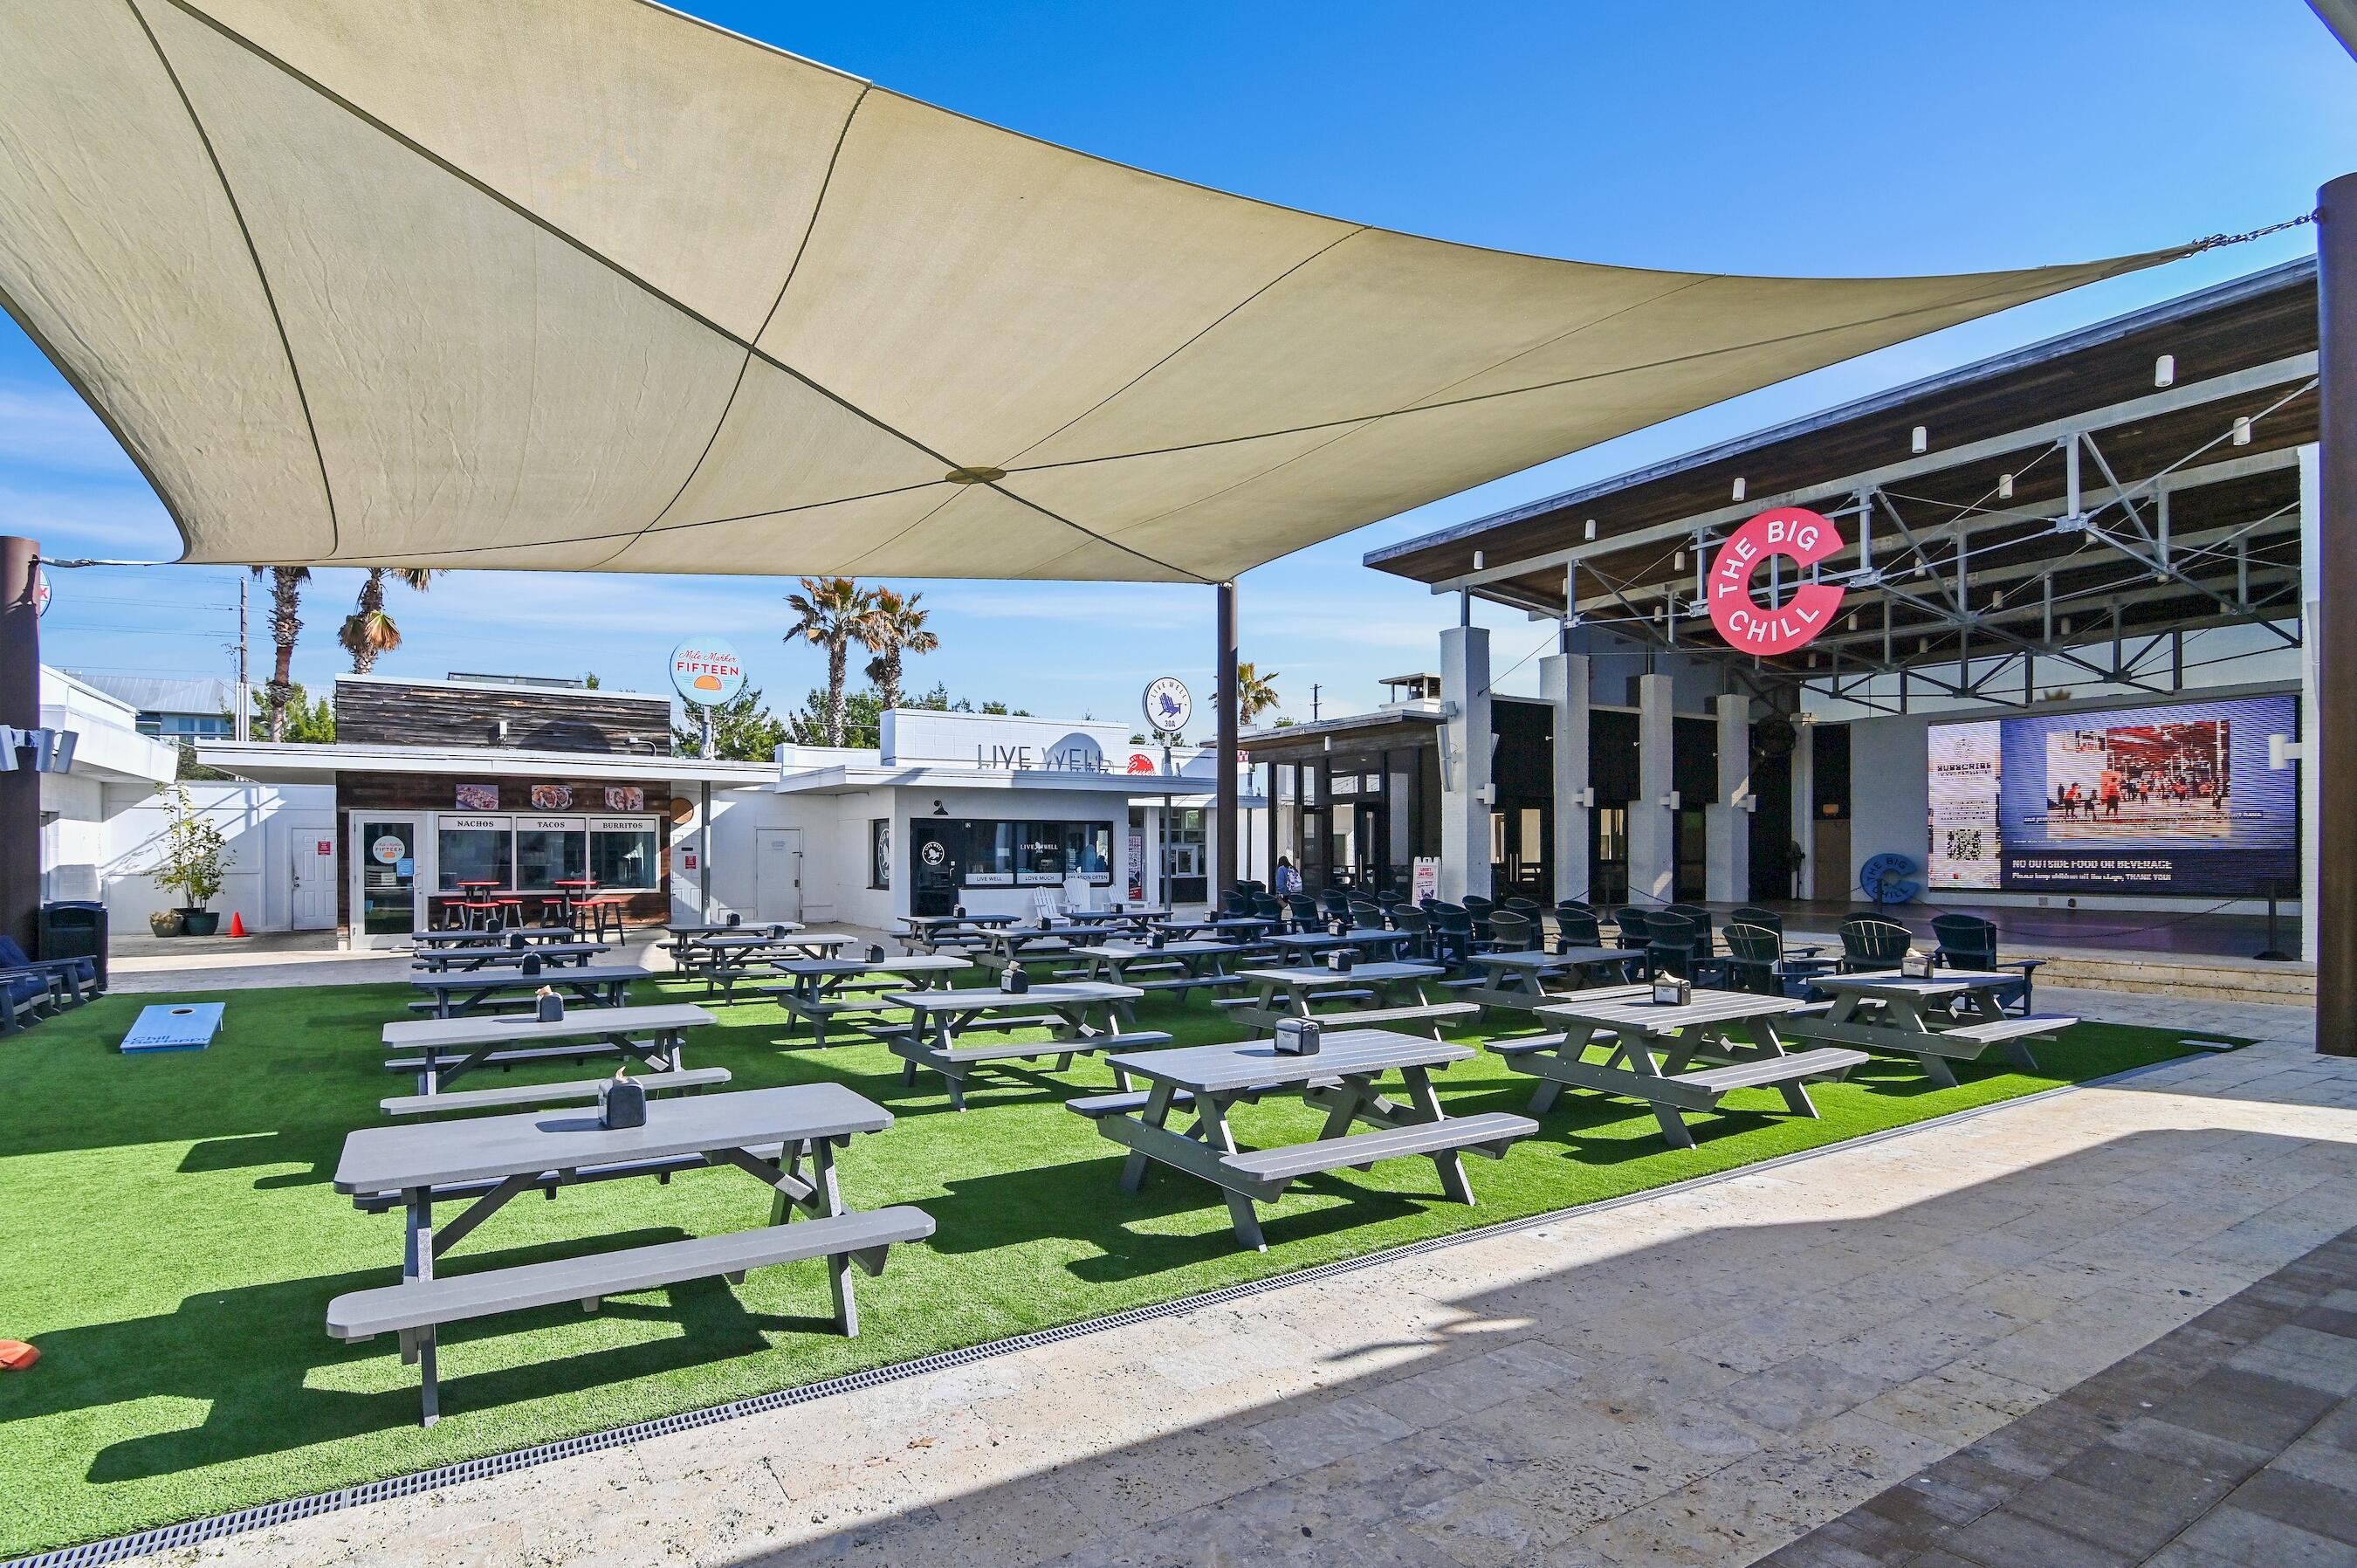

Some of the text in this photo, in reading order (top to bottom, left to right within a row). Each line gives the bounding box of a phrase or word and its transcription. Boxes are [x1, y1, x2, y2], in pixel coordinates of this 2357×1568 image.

[1718, 520, 1818, 599] THE BIG
[1728, 610, 1820, 643] CHILL
[679, 650, 738, 663] Mile Marker
[677, 662, 739, 676] FIFTEEN
[1151, 681, 1187, 699] LIVE WELL
[978, 744, 1032, 771] LIVE
[1041, 746, 1109, 774] WELL
[1937, 762, 1991, 772] SUBSCRIBE
[2028, 860, 2069, 869] OUTSIDE
[2071, 860, 2098, 869] FOOD
[2100, 860, 2115, 869] OR
[2117, 860, 2172, 870] BEVERAGE
